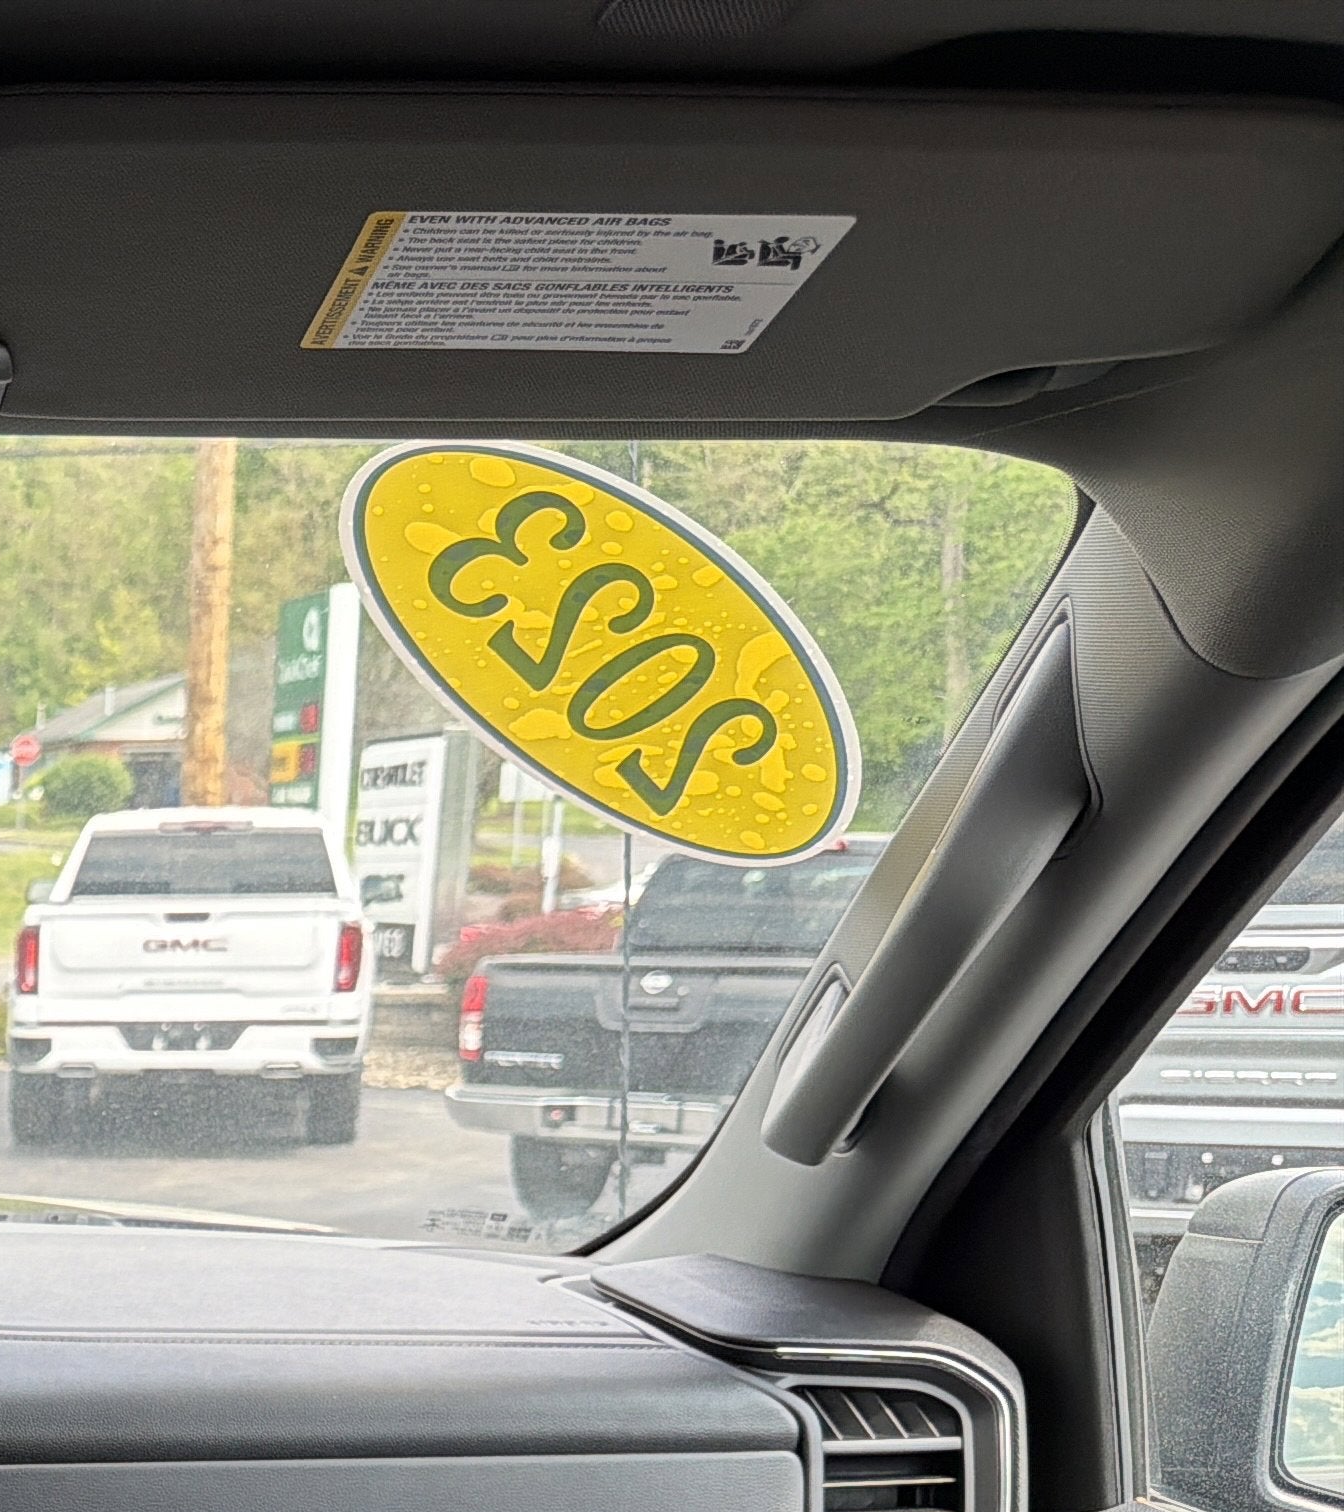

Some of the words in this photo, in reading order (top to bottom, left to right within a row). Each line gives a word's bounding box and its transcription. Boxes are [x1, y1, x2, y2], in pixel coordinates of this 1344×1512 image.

[408, 215, 453, 224] EVEN
[455, 215, 499, 224] WITH
[499, 216, 590, 226] ADVANCED
[592, 217, 623, 226] AIR
[625, 217, 672, 227] BAGS
[355, 218, 395, 264] WARNING
[418, 282, 458, 290] AVEC
[460, 282, 490, 291] DES
[492, 282, 532, 291] SACS
[535, 283, 629, 292] GONFLABLES
[631, 284, 735, 293] INTELLIGENTS
[356, 816, 423, 846] BUICK
[143, 938, 228, 953] GMC
[1175, 984, 1344, 1018] GMC
